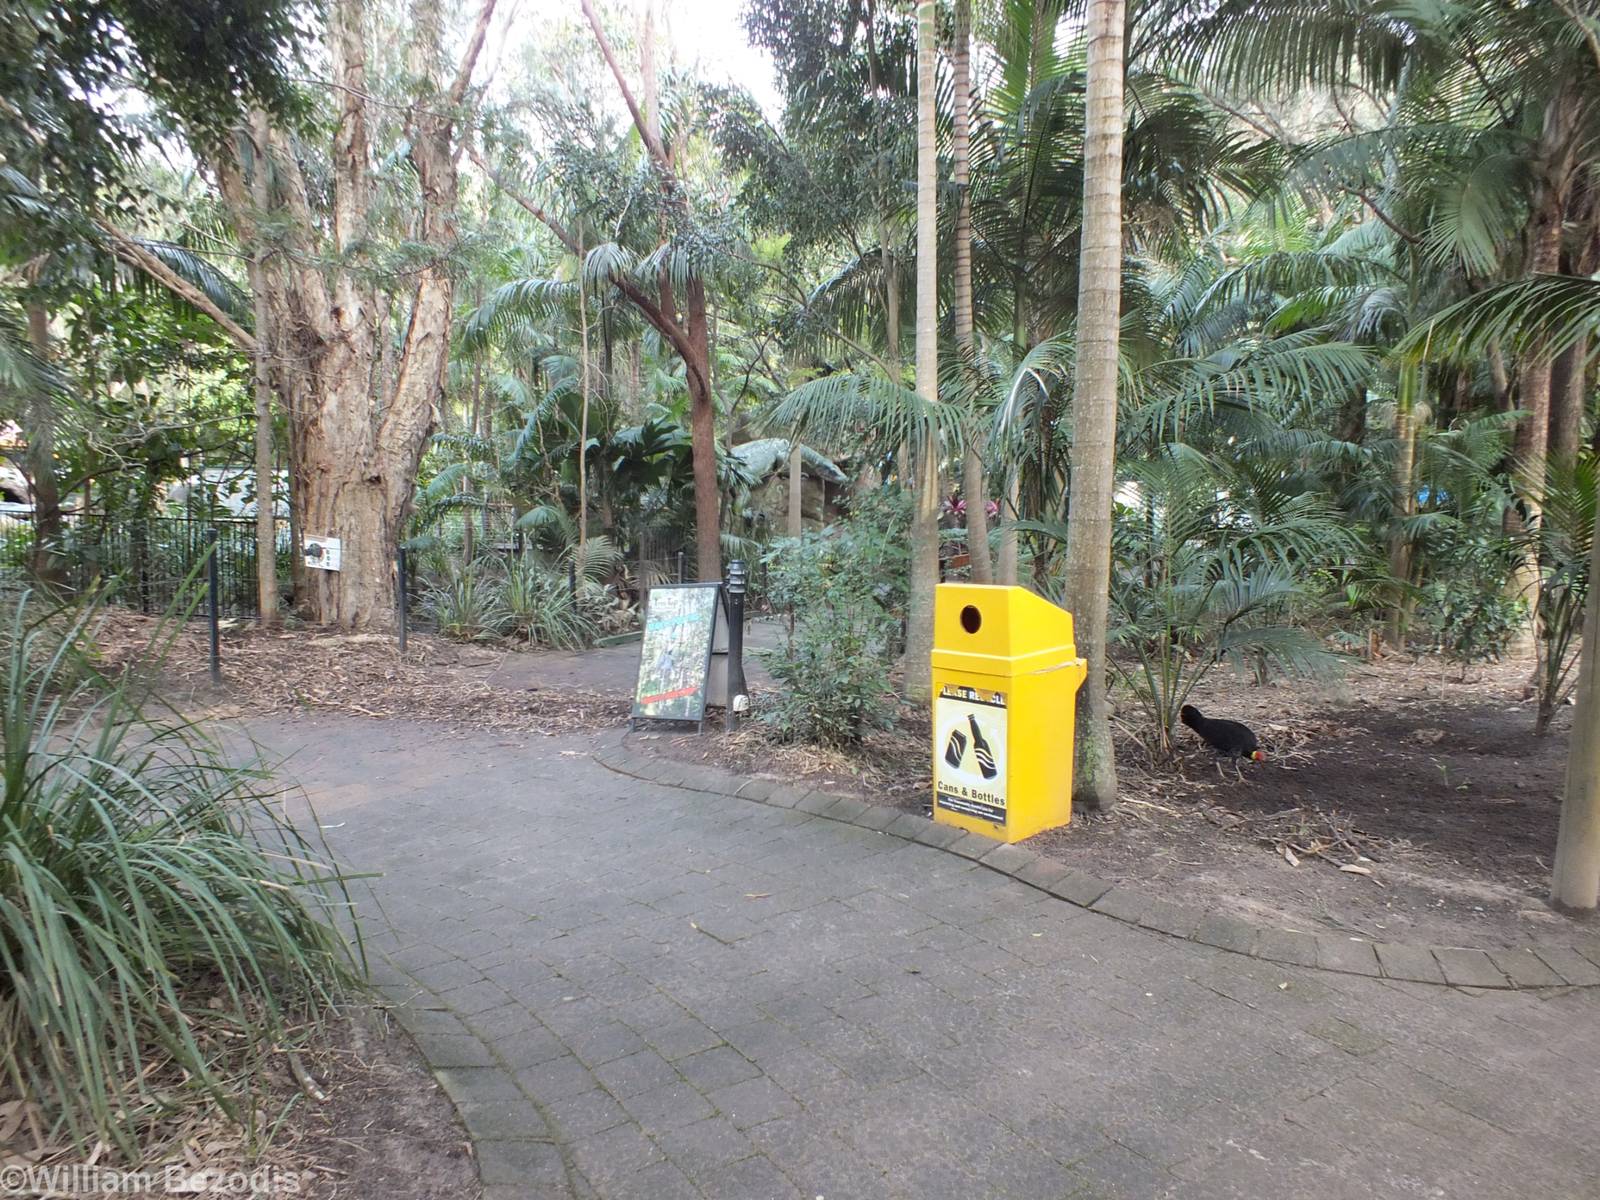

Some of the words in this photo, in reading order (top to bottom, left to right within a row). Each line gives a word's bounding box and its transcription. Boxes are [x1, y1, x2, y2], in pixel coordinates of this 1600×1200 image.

[937, 780, 959, 794] Cans
[961, 786, 968, 797] &
[971, 789, 1006, 806] Bottles
